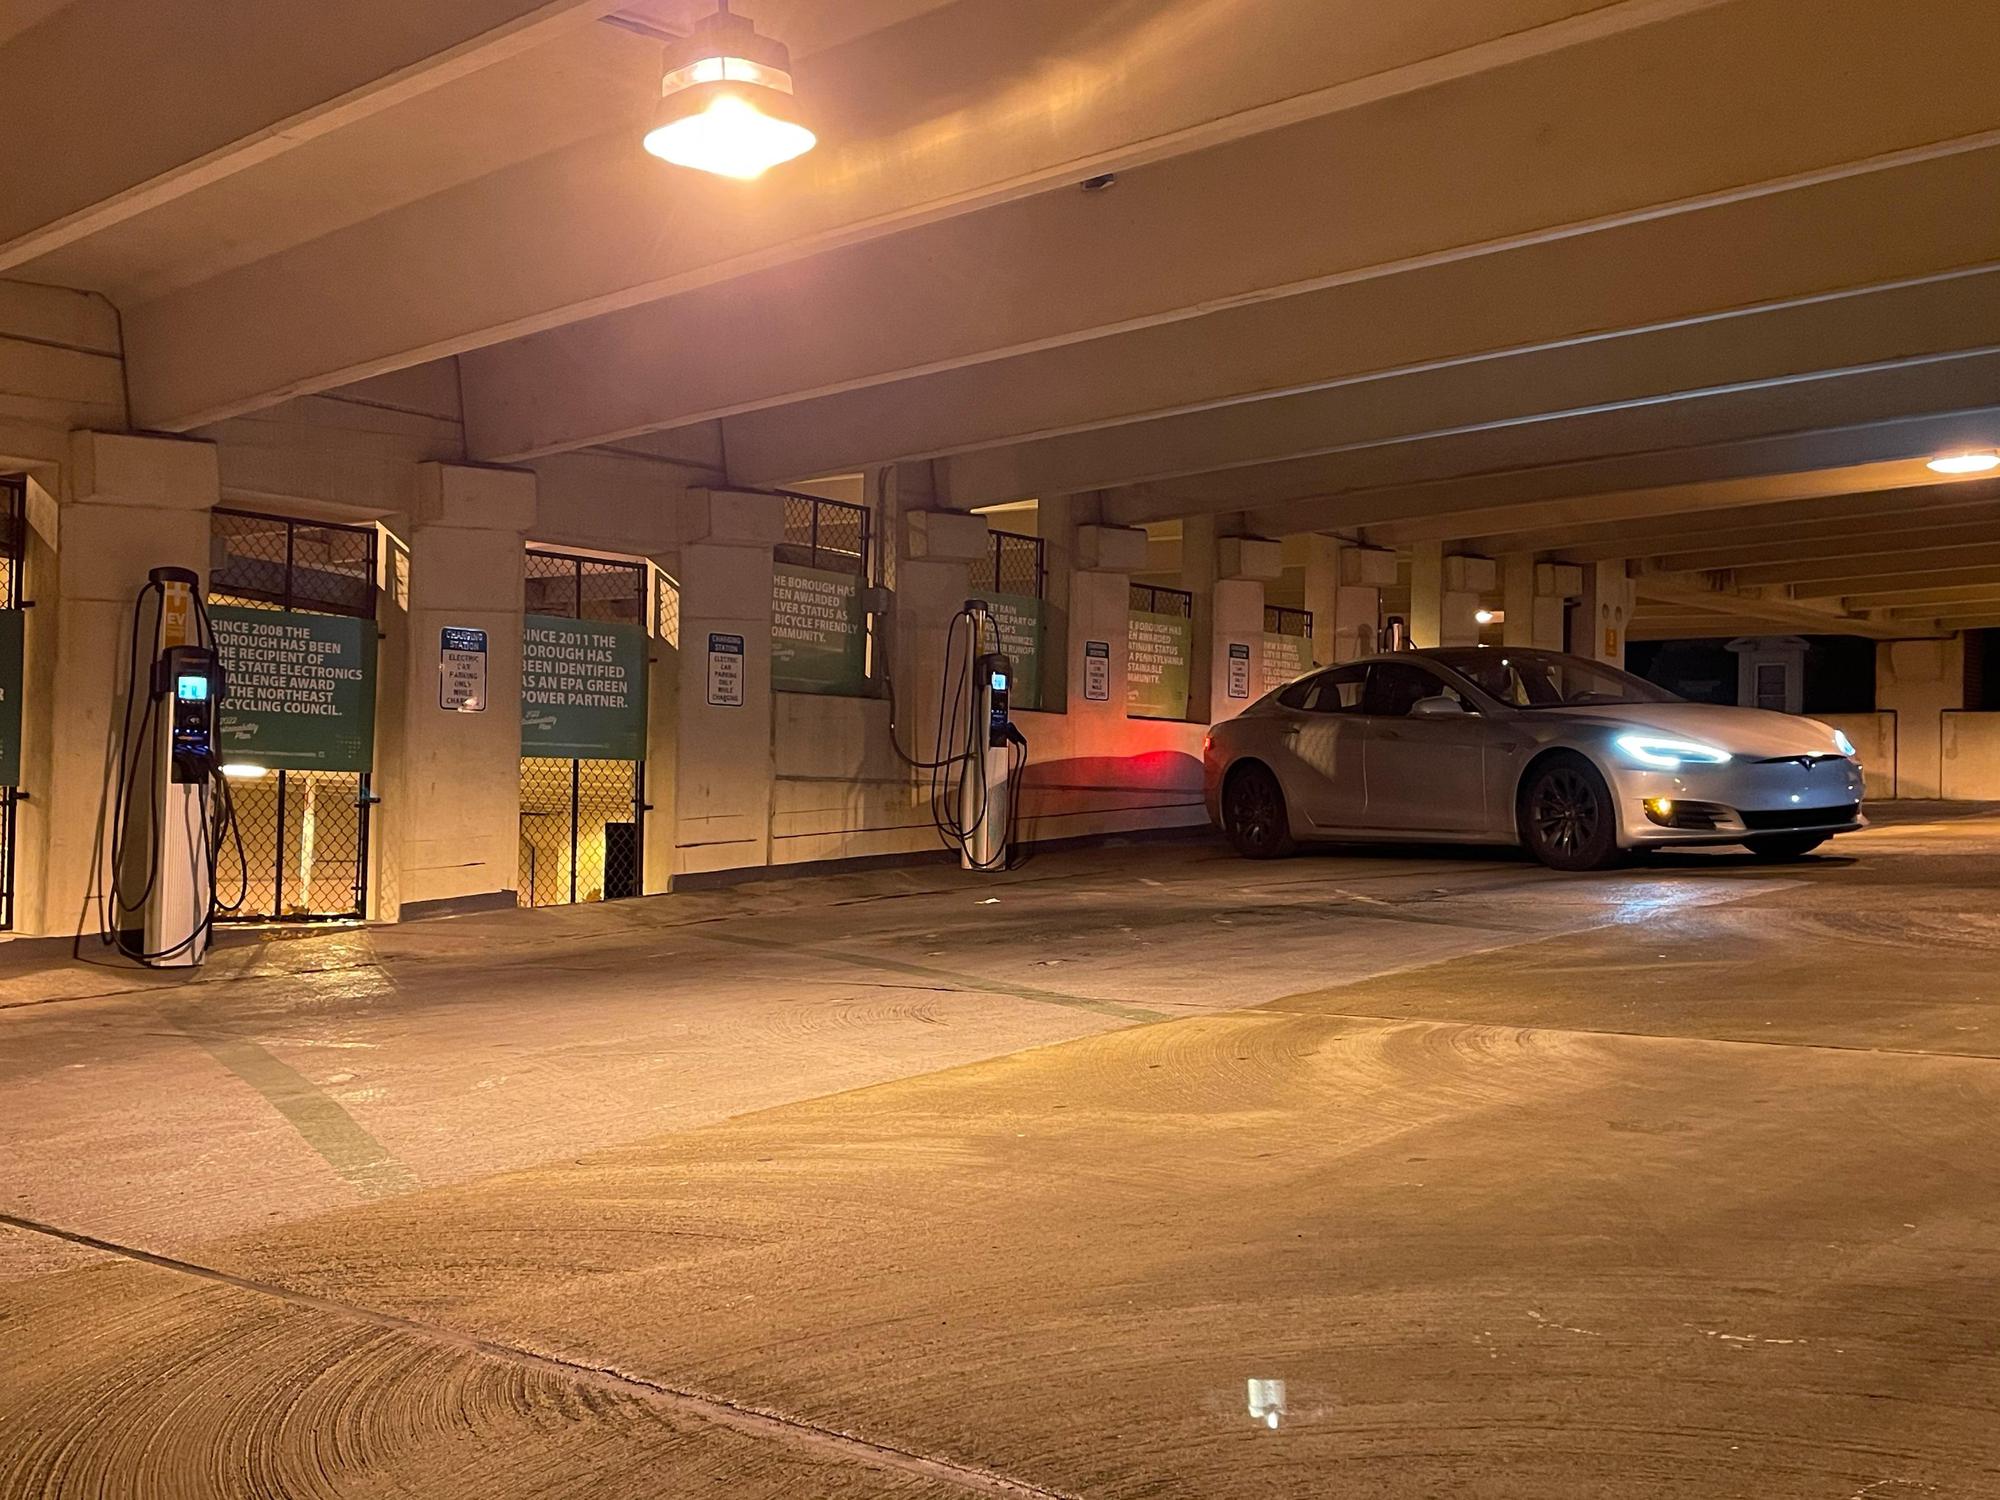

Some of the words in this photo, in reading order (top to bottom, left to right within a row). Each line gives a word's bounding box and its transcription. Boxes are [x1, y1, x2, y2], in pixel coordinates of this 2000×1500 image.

[774, 576, 786, 586] HE
[788, 577, 835, 594] BOROUGH
[837, 585, 856, 597] HAS
[774, 587, 792, 600] EEN
[793, 590, 840, 606] AWARDED
[167, 612, 185, 624] EV
[772, 600, 798, 613] ILVER
[800, 604, 834, 618] STATUS
[836, 610, 848, 621] AS
[211, 620, 248, 634] SINCE
[252, 624, 283, 637] 2008
[285, 626, 310, 639] THE
[775, 614, 813, 628] BICYCLE
[814, 619, 858, 634] FRIENDLY
[1010, 616, 1026, 625] PART
[523, 629, 556, 643] INCE
[559, 633, 589, 646] 2011
[592, 635, 616, 648] THE
[772, 626, 826, 642] OMMUNITY.
[218, 646, 236, 658] HE
[239, 648, 304, 664] RECIPIENT
[307, 654, 324, 665] OF
[280, 640, 306, 651] HAS
[309, 642, 341, 654] BEEN
[587, 650, 612, 662] HAS
[1128, 641, 1154, 652] ATINUM
[1154, 644, 1178, 656] STATUS
[218, 660, 236, 671] HE
[238, 661, 276, 674] STATE
[280, 664, 363, 680] ELECTRONICS
[556, 662, 625, 678] IDENTIFIED
[1128, 662, 1162, 674] STAINABLE
[225, 672, 286, 688] ALLENGE
[289, 678, 336, 691] AWARD
[538, 677, 557, 690] AN
[560, 678, 584, 690] EPA
[587, 680, 628, 694] GREEN
[229, 686, 254, 698] THE
[257, 688, 333, 704] NORTHEAST
[568, 694, 628, 708] PARTNER.
[220, 698, 281, 712] ECYCLING
[284, 702, 343, 716] COUNCIL.
